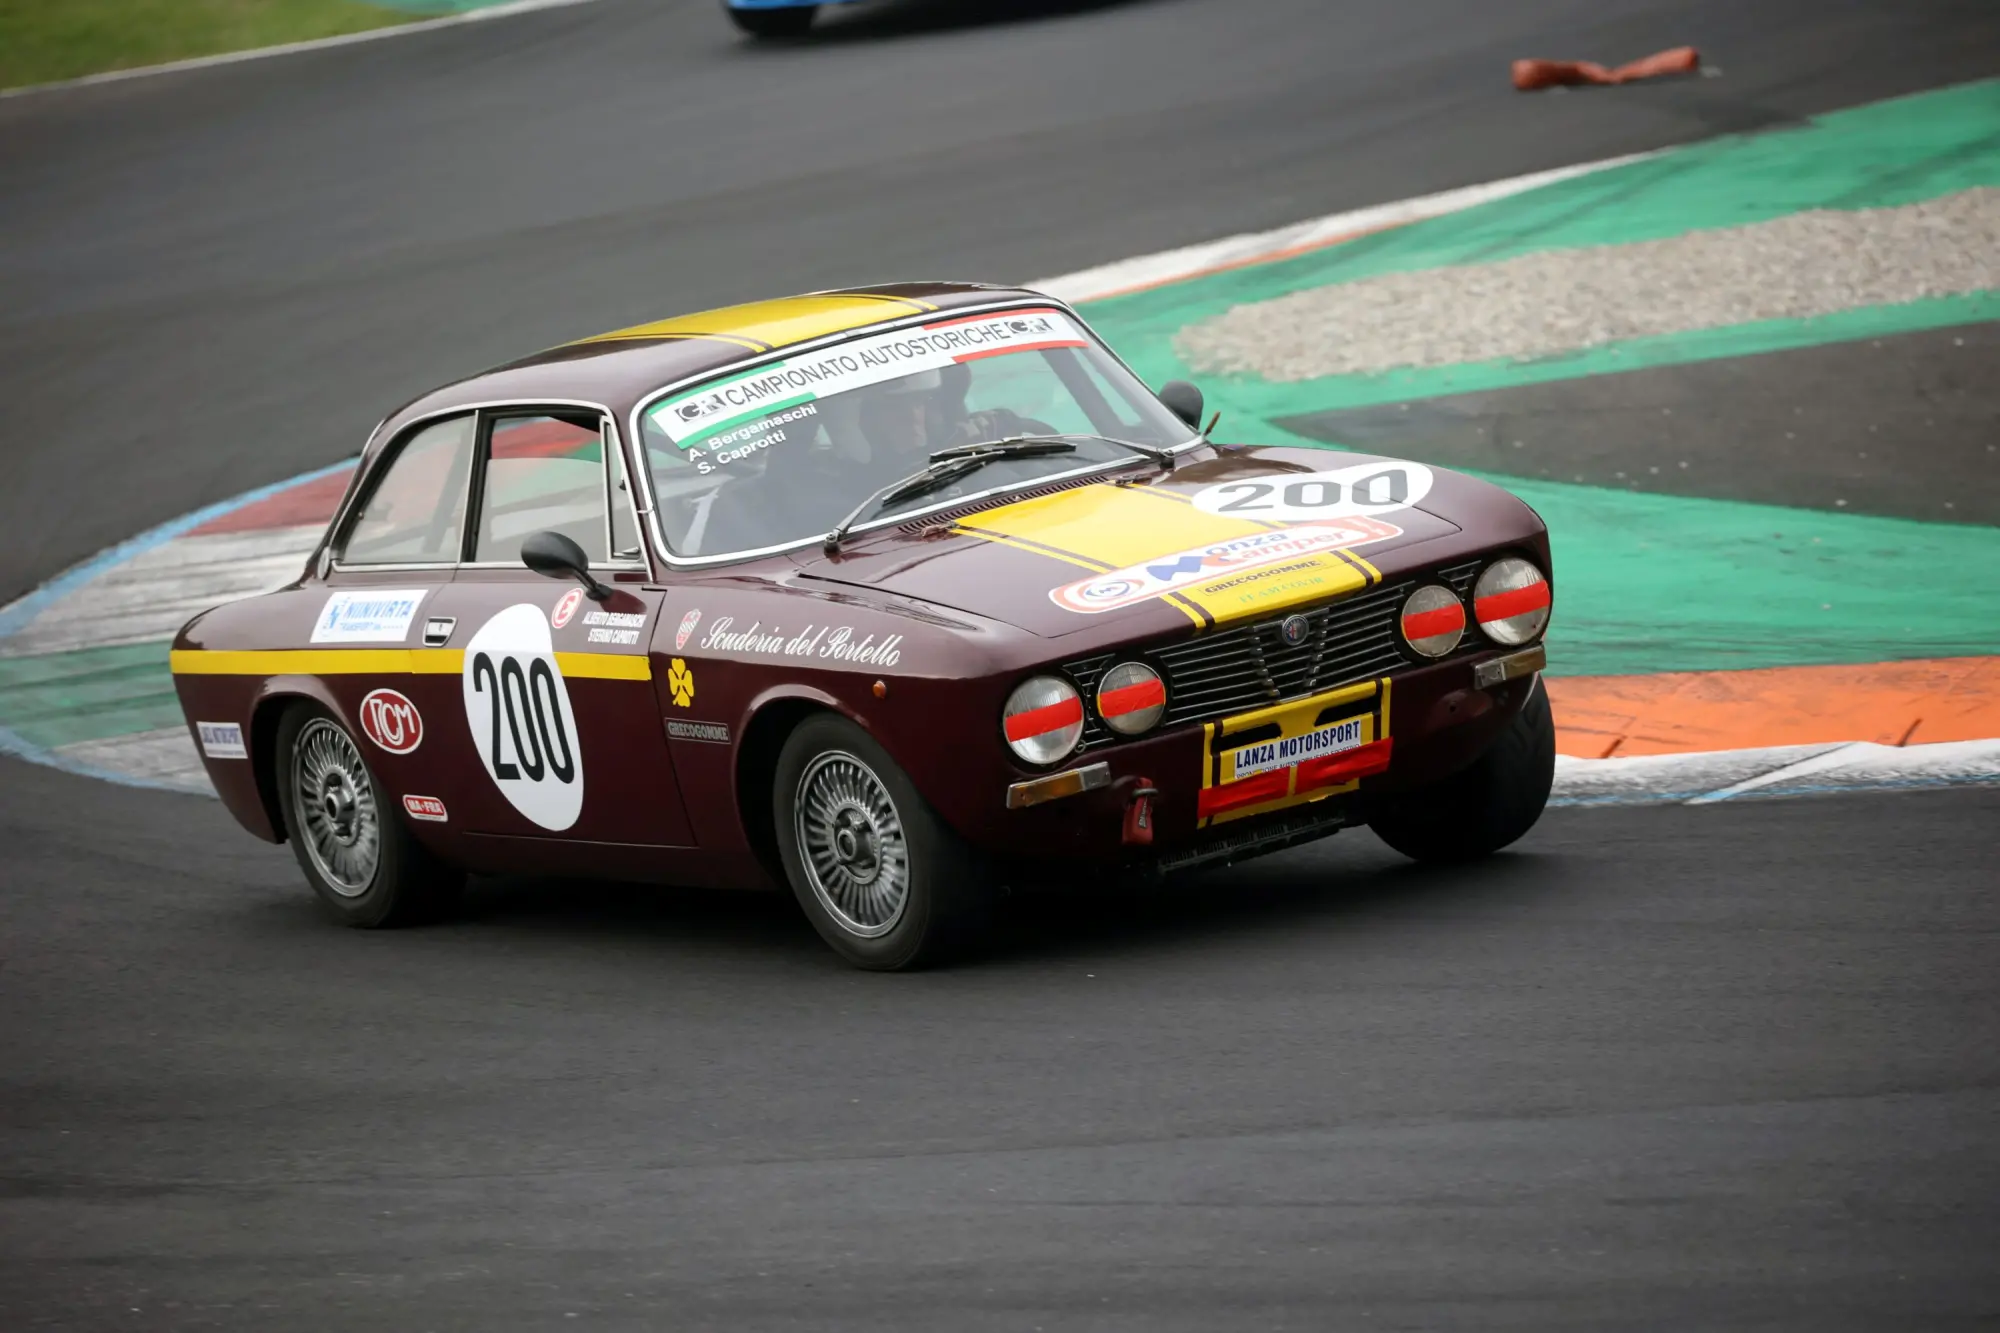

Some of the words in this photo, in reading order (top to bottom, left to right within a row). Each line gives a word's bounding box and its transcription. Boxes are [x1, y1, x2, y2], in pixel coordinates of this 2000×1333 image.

[725, 355, 859, 406] CAMPIONATO
[861, 322, 1011, 369] AUTOSTORICHE
[689, 447, 707, 463] A.
[708, 403, 818, 451] Bergamaschi
[697, 461, 716, 475] S.
[716, 430, 787, 467] Caprotti
[1218, 468, 1409, 512] 200
[1204, 560, 1322, 594] GRECOGOMME
[344, 600, 415, 619] NIINIVIRTA
[701, 616, 783, 652] Scuderia
[784, 623, 829, 657] del
[819, 626, 904, 667] Portello
[473, 652, 575, 785] 200
[667, 721, 729, 741] GRECOGOMME
[1236, 743, 1275, 769] LANZA
[1279, 720, 1360, 759] MOTORSPORT
